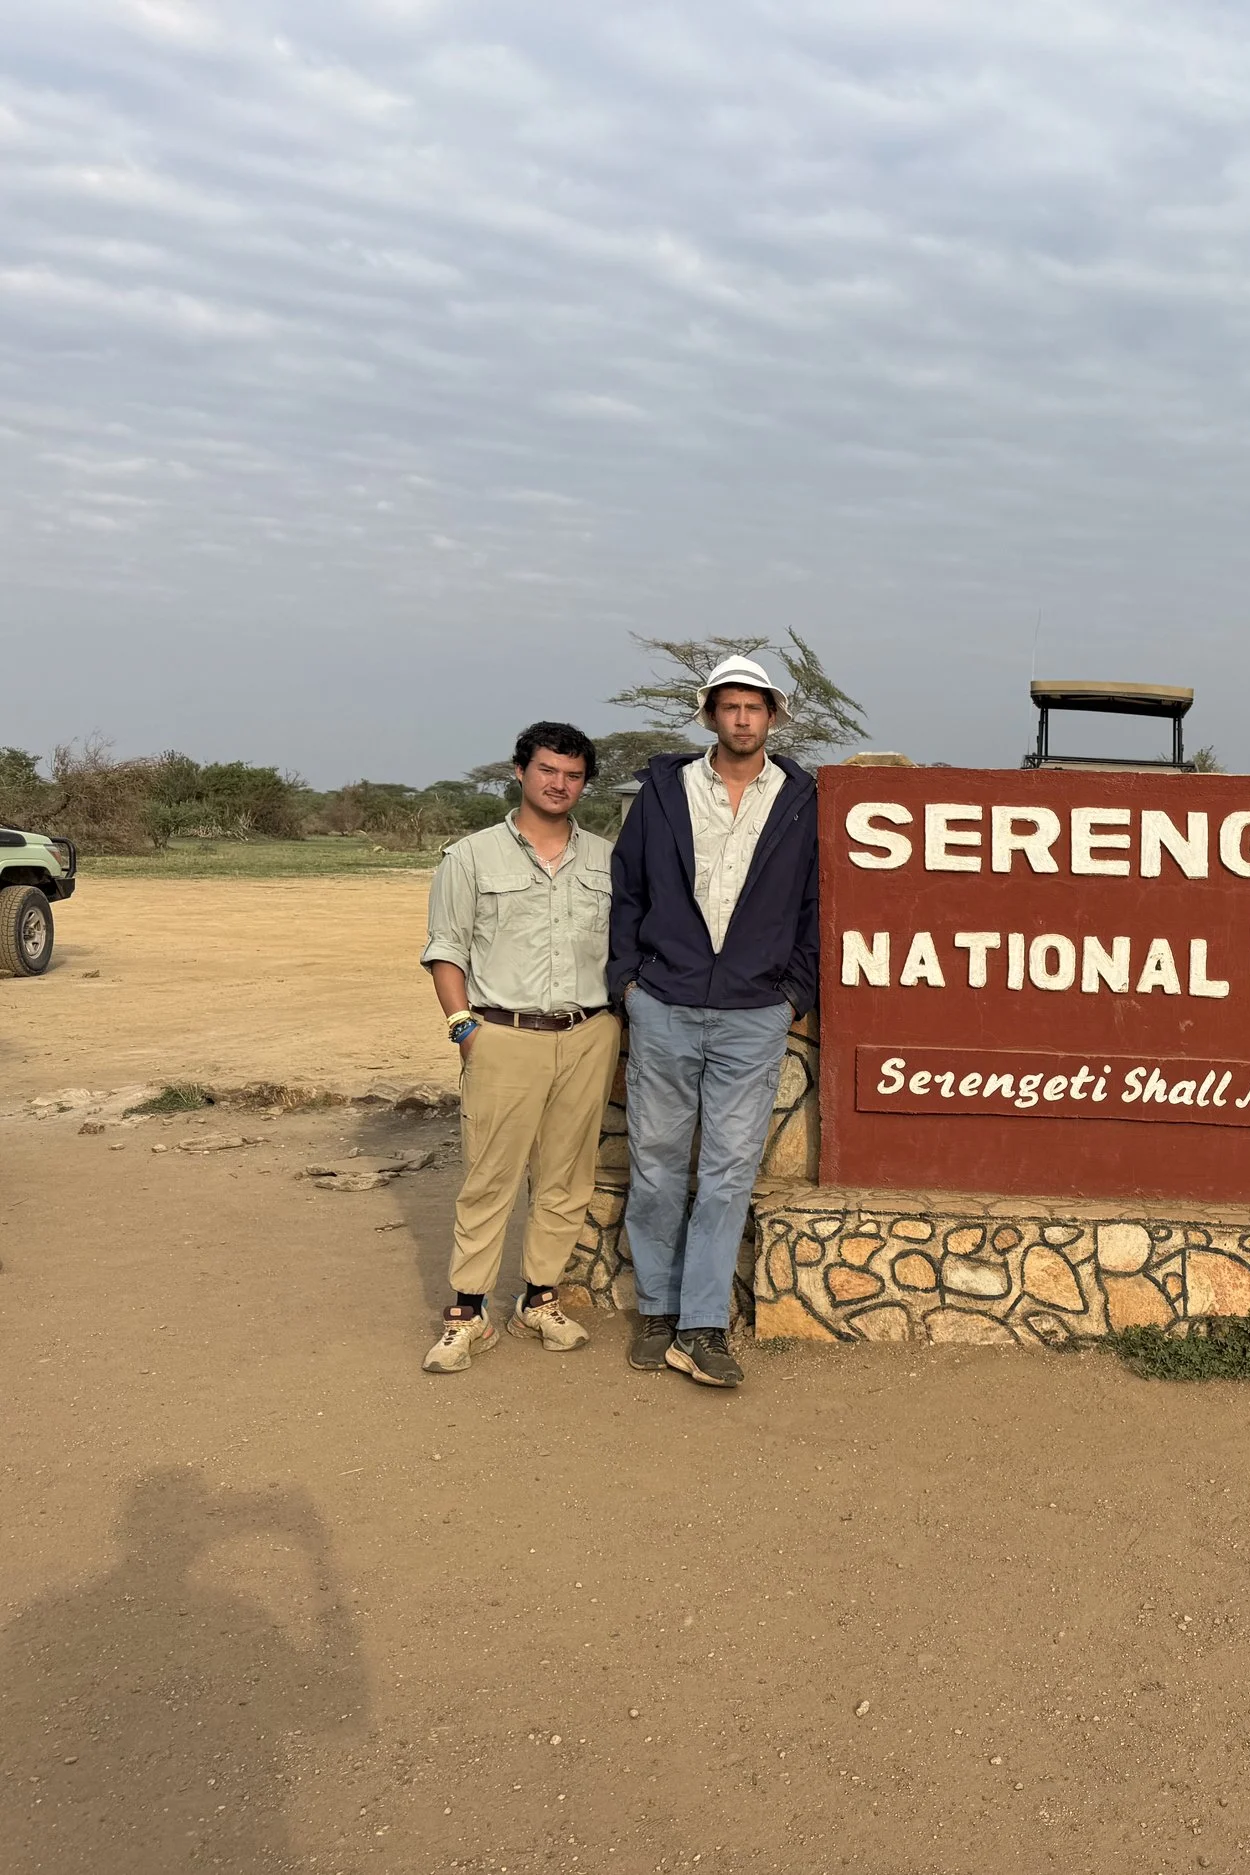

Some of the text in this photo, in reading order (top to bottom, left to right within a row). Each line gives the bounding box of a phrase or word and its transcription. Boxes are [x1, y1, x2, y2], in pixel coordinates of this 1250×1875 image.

[841, 930, 1230, 999] NATIONAL
[876, 1057, 1112, 1109] Serengeti
[1120, 1066, 1233, 1108] Shall
